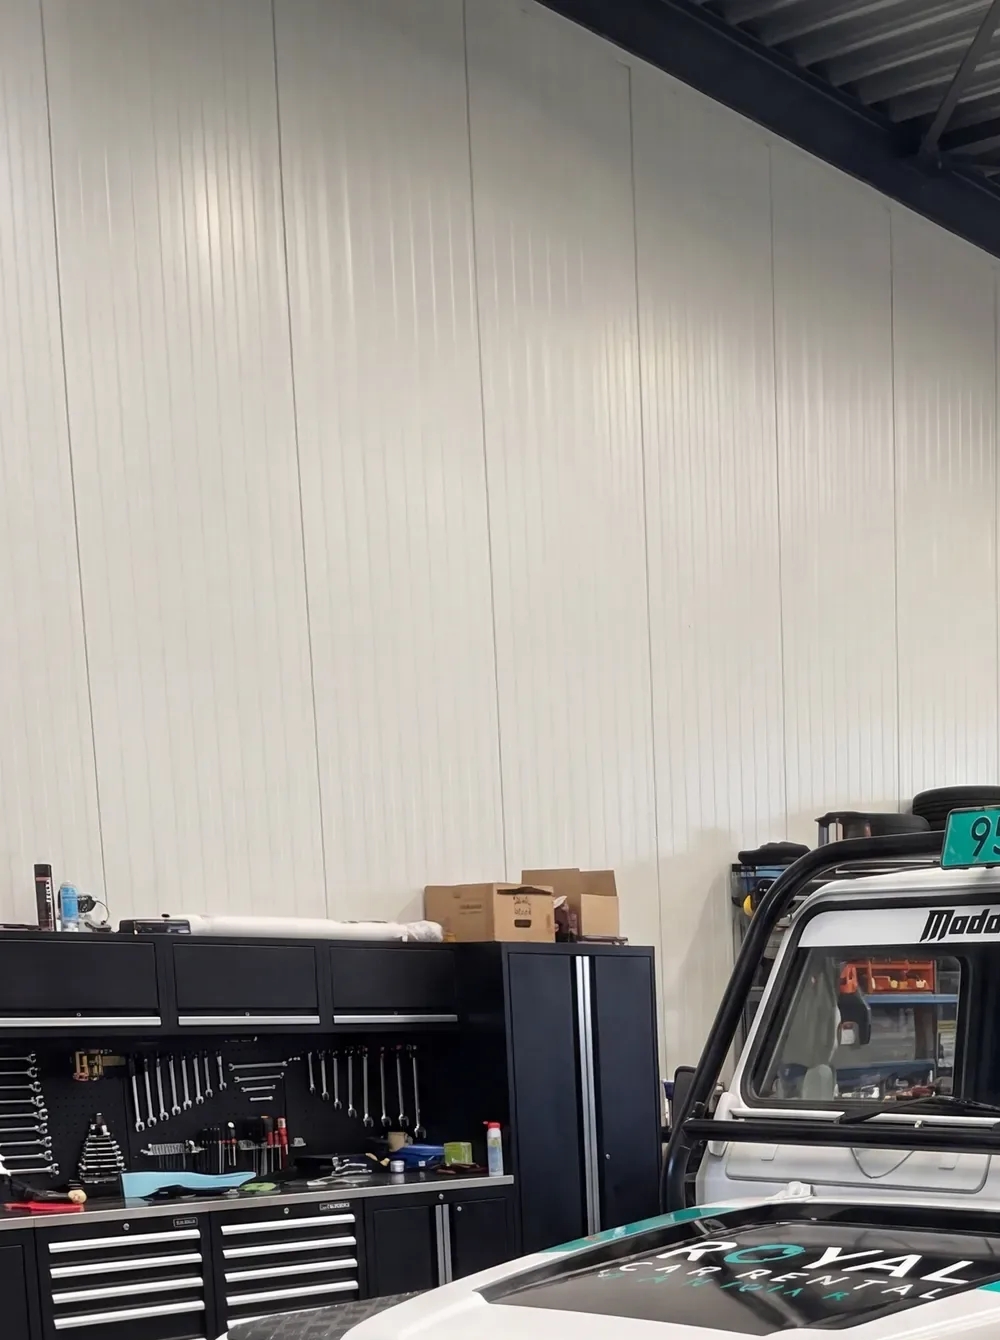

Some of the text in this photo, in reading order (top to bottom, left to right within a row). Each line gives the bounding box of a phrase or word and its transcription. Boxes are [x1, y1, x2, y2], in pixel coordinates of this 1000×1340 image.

[619, 1262, 943, 1300] CAR RENTAL
[656, 1241, 974, 1285] ROYAL
